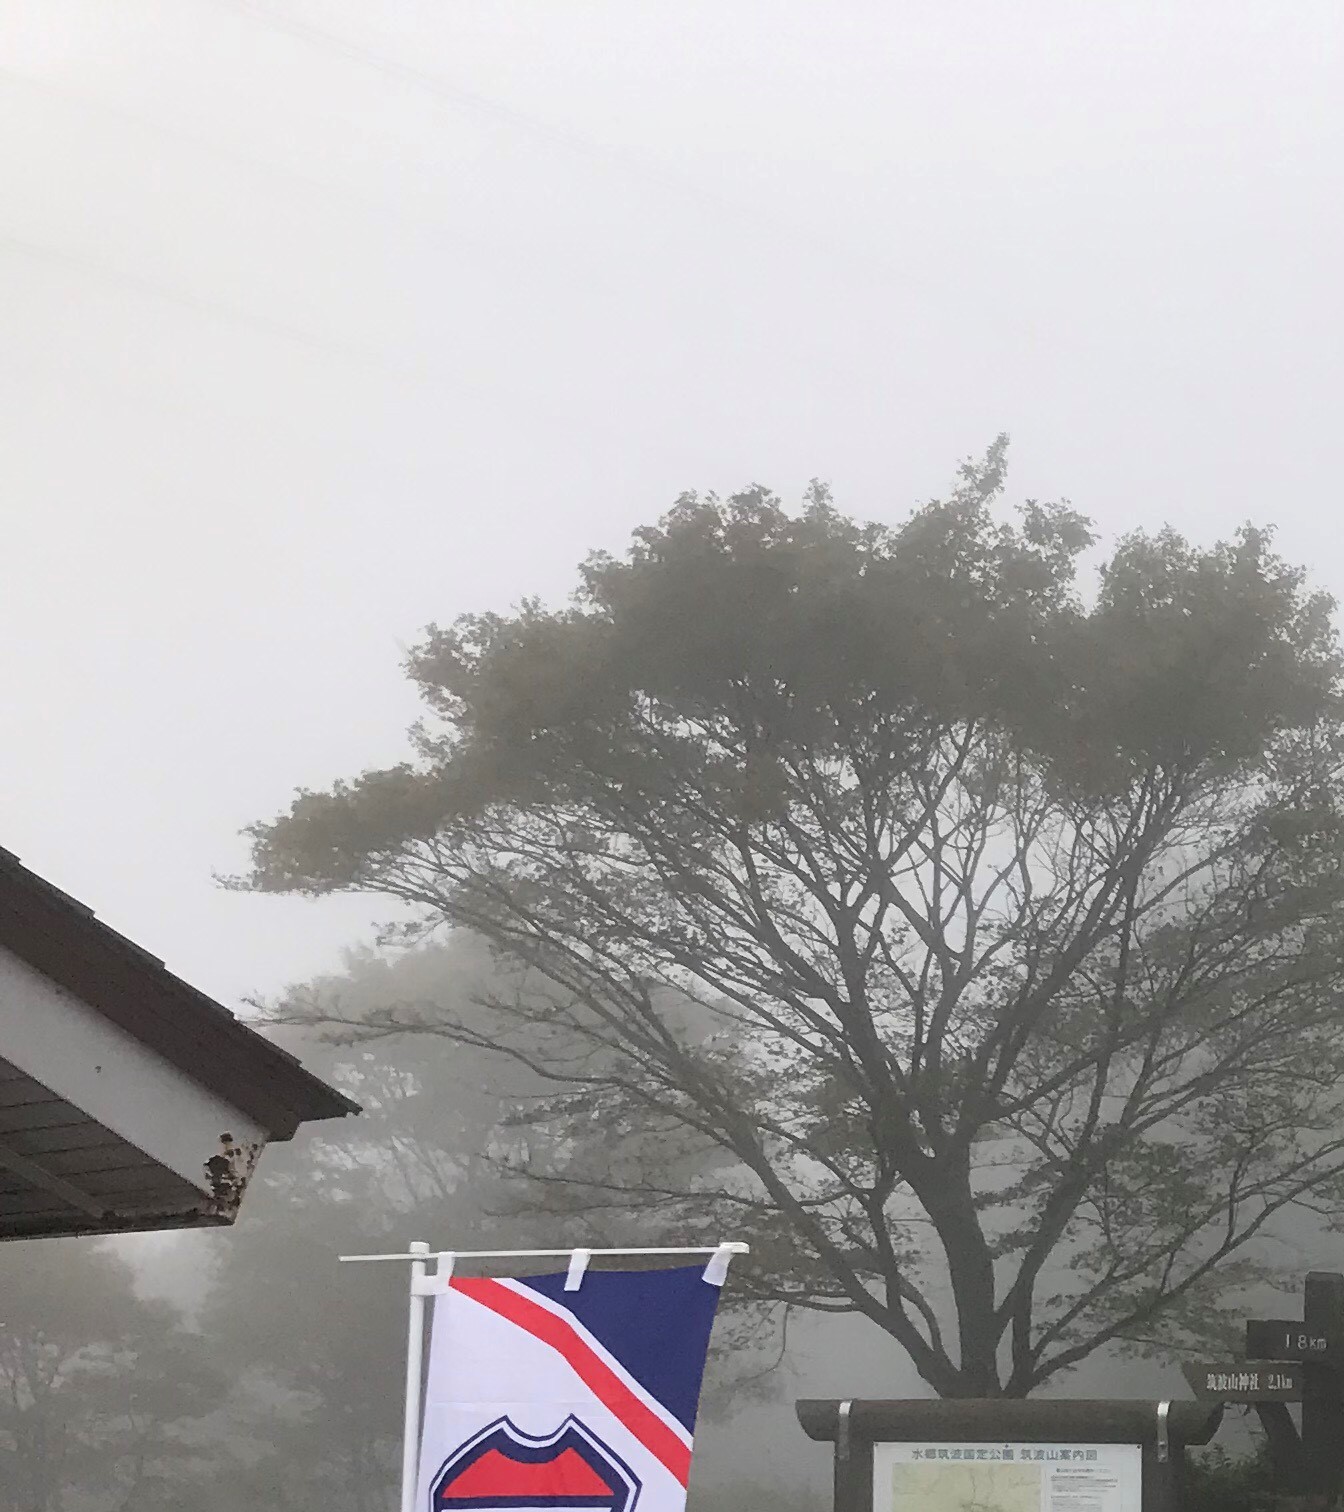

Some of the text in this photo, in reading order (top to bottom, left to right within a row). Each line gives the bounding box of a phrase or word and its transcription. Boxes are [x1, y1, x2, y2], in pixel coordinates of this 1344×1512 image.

[1206, 1373, 1260, 1392] 筑波山神社
